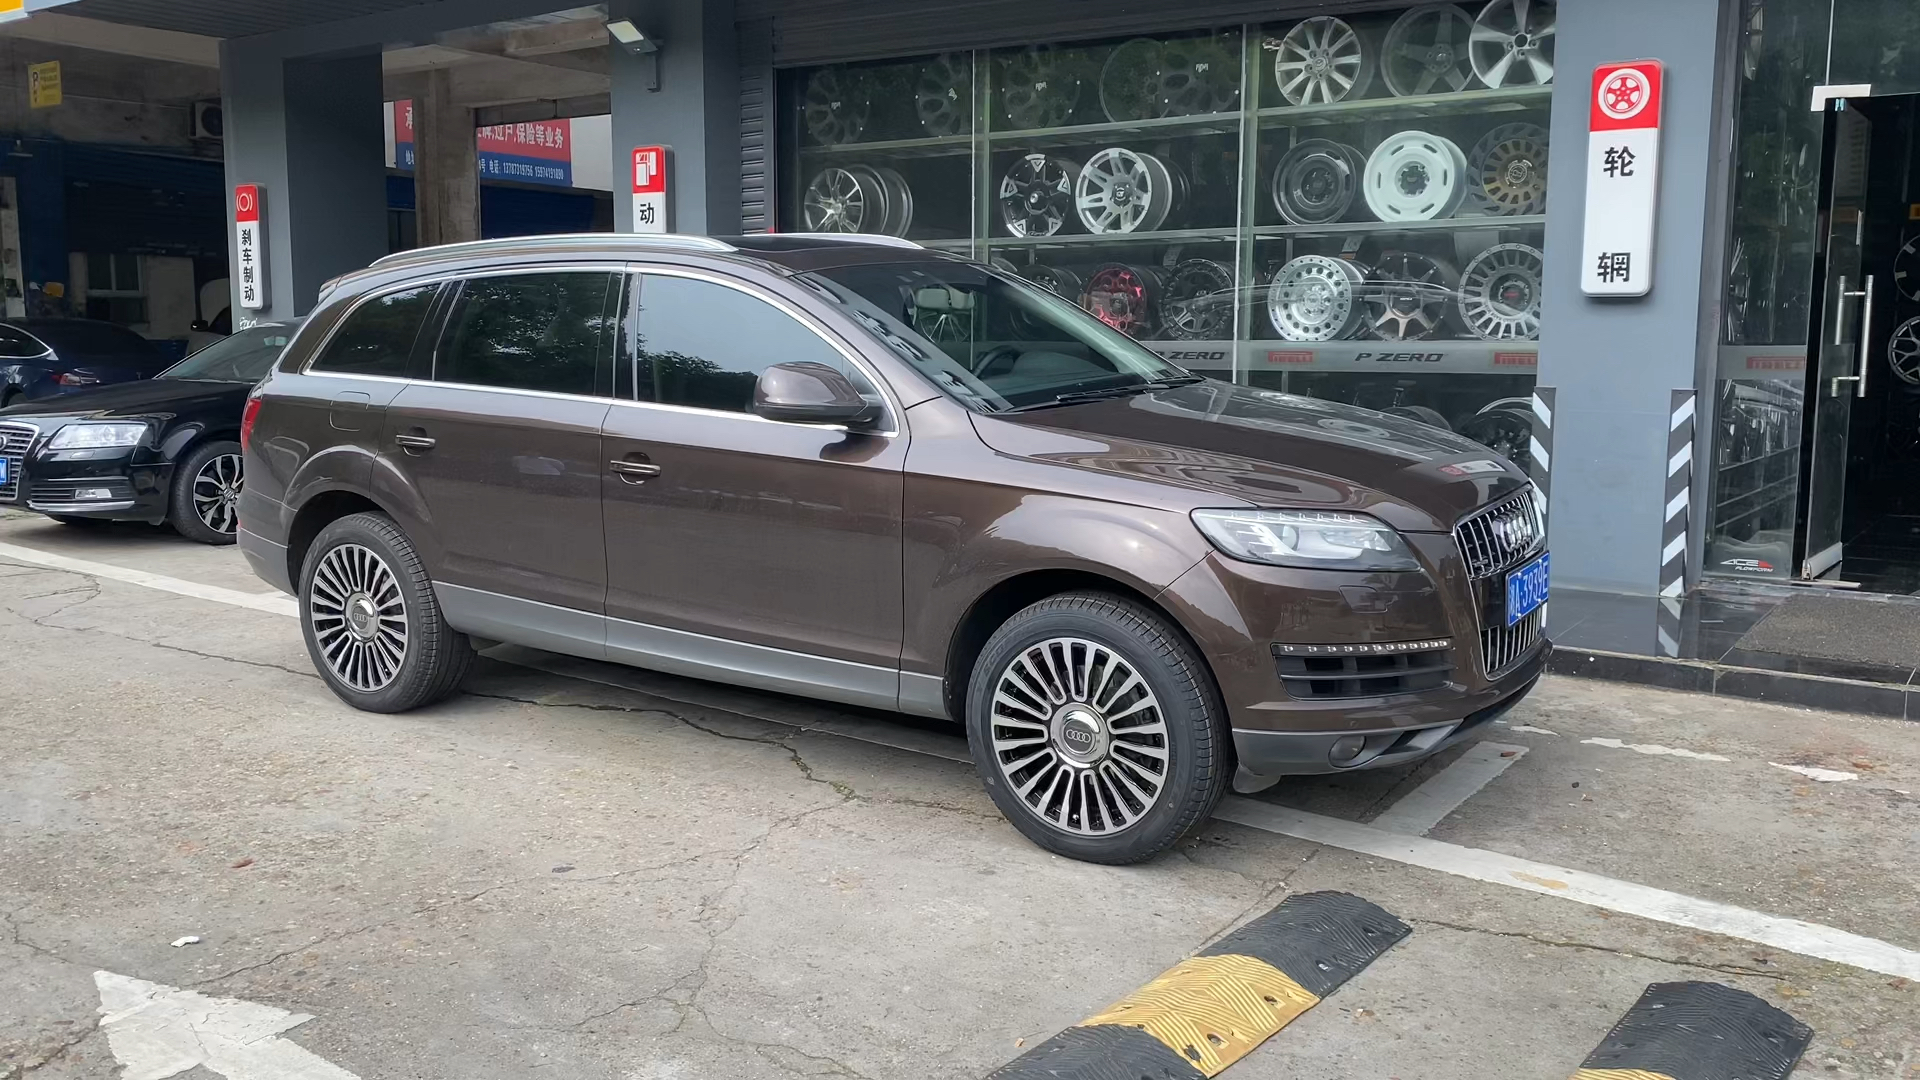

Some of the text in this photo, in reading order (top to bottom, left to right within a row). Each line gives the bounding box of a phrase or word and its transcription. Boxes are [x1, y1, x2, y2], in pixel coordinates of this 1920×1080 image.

[639, 202, 655, 225] 动
[241, 228, 255, 302] 刹车制动
[1168, 351, 1226, 361] ZERO
[1355, 352, 1444, 362] P ZERO
